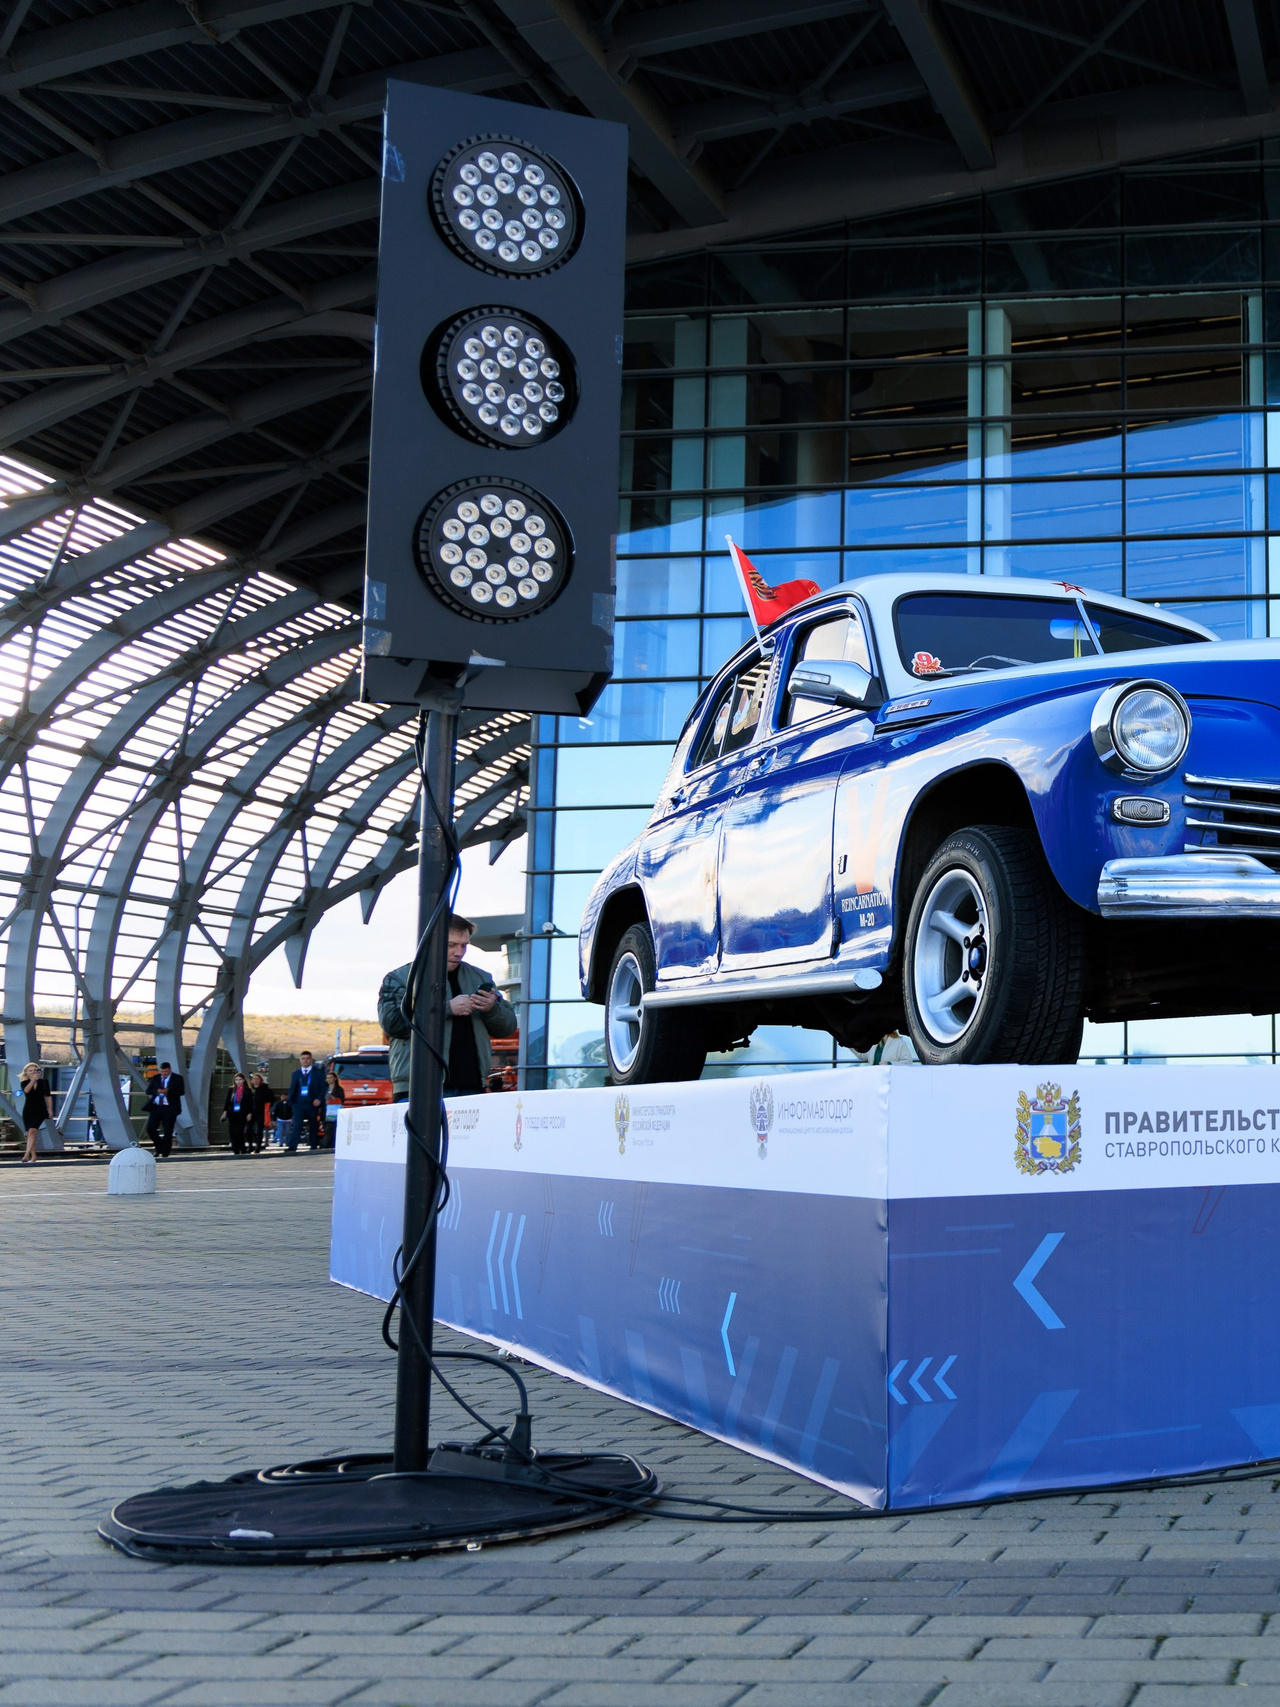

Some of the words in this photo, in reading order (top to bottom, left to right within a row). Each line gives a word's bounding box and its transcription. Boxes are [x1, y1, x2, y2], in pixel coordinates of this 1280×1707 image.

[842, 892, 888, 912] REINCARNATION
[859, 912, 875, 927] M-20
[778, 1099, 854, 1122] ИНФОРМАВТОДОР
[1105, 1138, 1266, 1158] СТАВРОПОЛЬСКОГО
